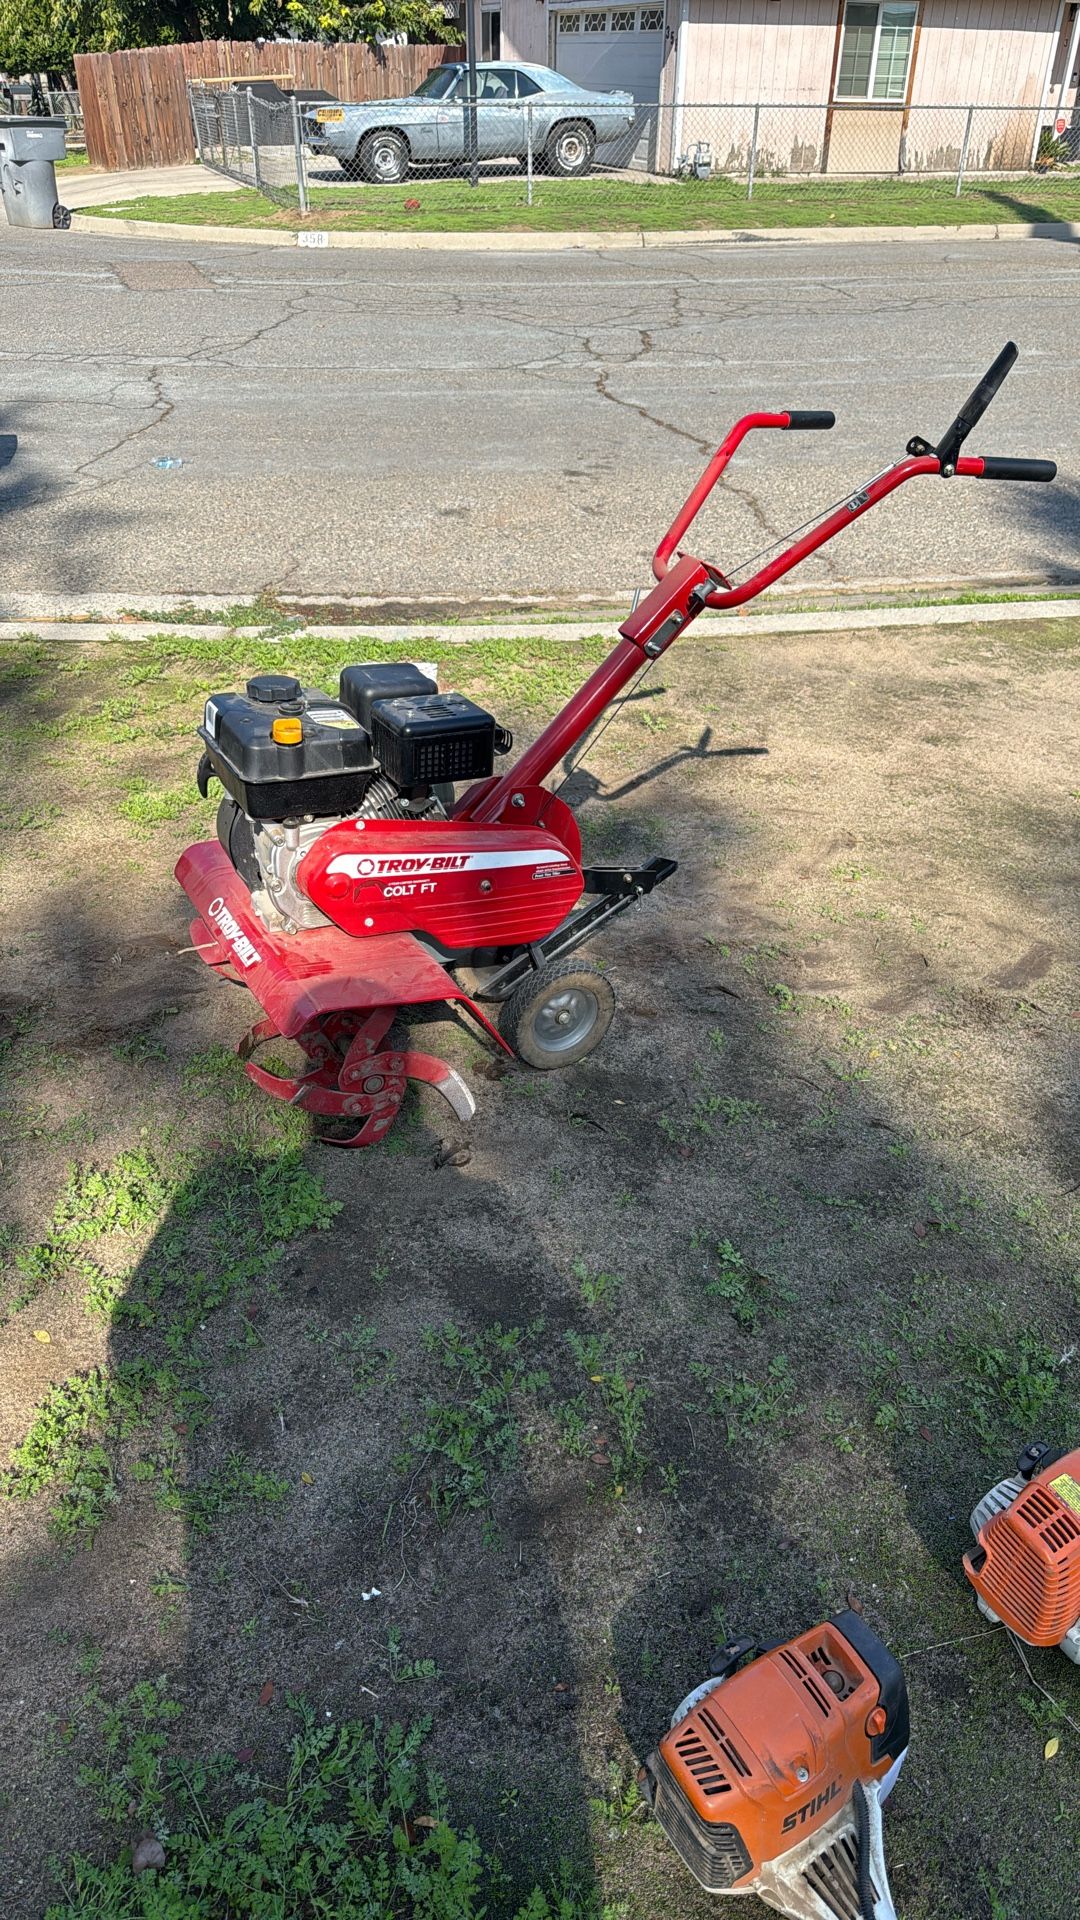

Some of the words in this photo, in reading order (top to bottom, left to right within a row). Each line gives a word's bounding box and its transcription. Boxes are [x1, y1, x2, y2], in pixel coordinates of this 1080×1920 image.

[377, 855, 470, 873] TROY-BILT
[383, 885, 416, 898] COLT
[420, 882, 437, 894] FT
[214, 906, 262, 967] TROY-BILT
[781, 1781, 841, 1834] STIHL
